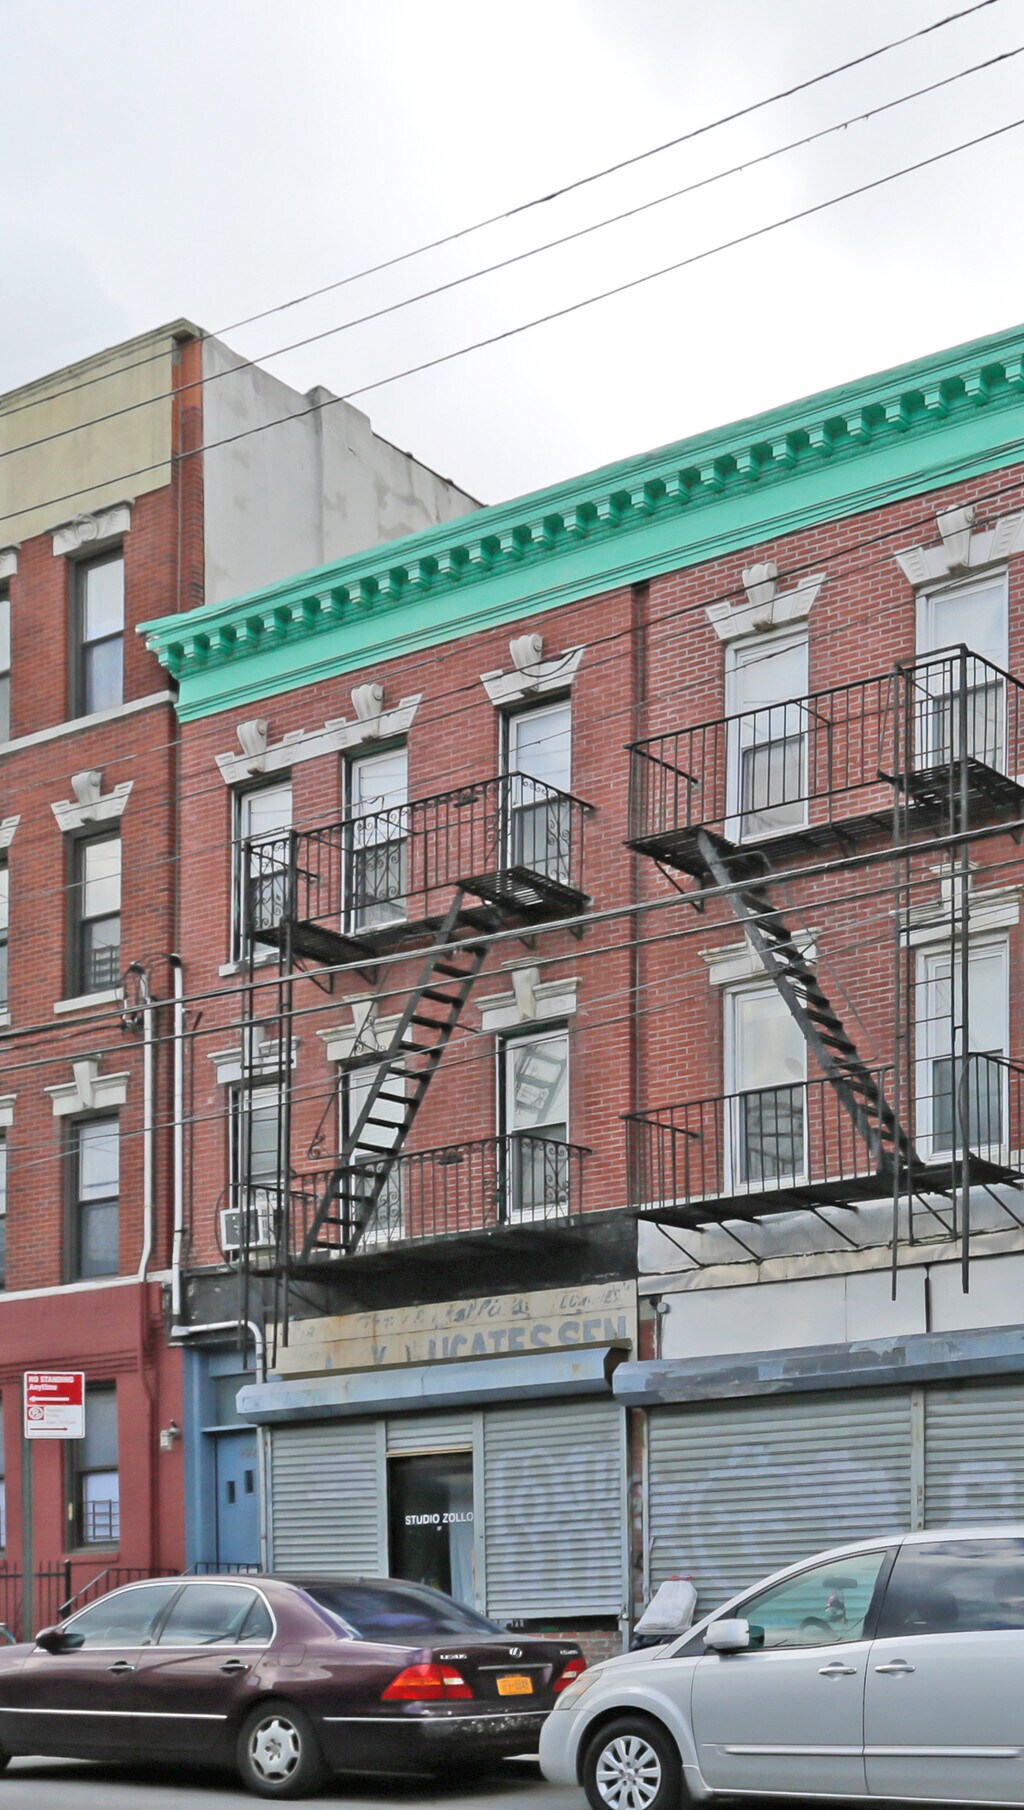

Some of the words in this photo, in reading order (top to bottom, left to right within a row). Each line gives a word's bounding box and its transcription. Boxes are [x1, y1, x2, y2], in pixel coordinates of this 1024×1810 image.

[28, 1375, 39, 1383] NO
[405, 1513, 440, 1525] STUDIO
[442, 1511, 474, 1523] ZOLLO
